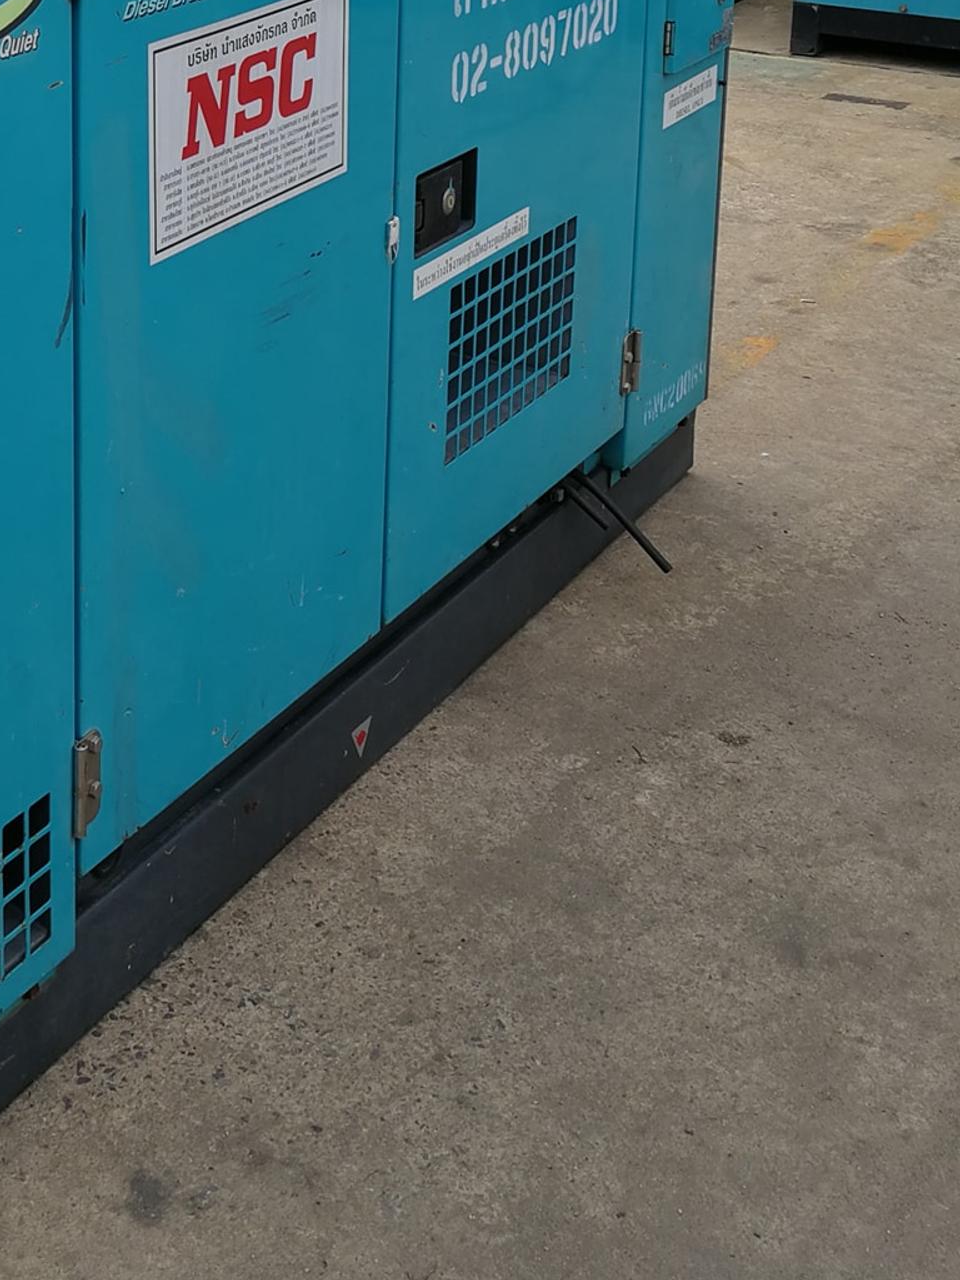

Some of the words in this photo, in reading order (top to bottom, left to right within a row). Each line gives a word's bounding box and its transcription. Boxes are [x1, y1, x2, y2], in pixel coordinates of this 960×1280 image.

[0, 28, 40, 58] Quiet
[187, 41, 218, 67] บริษัท
[291, 8, 317, 31] จำกัด
[181, 32, 318, 161] NSC
